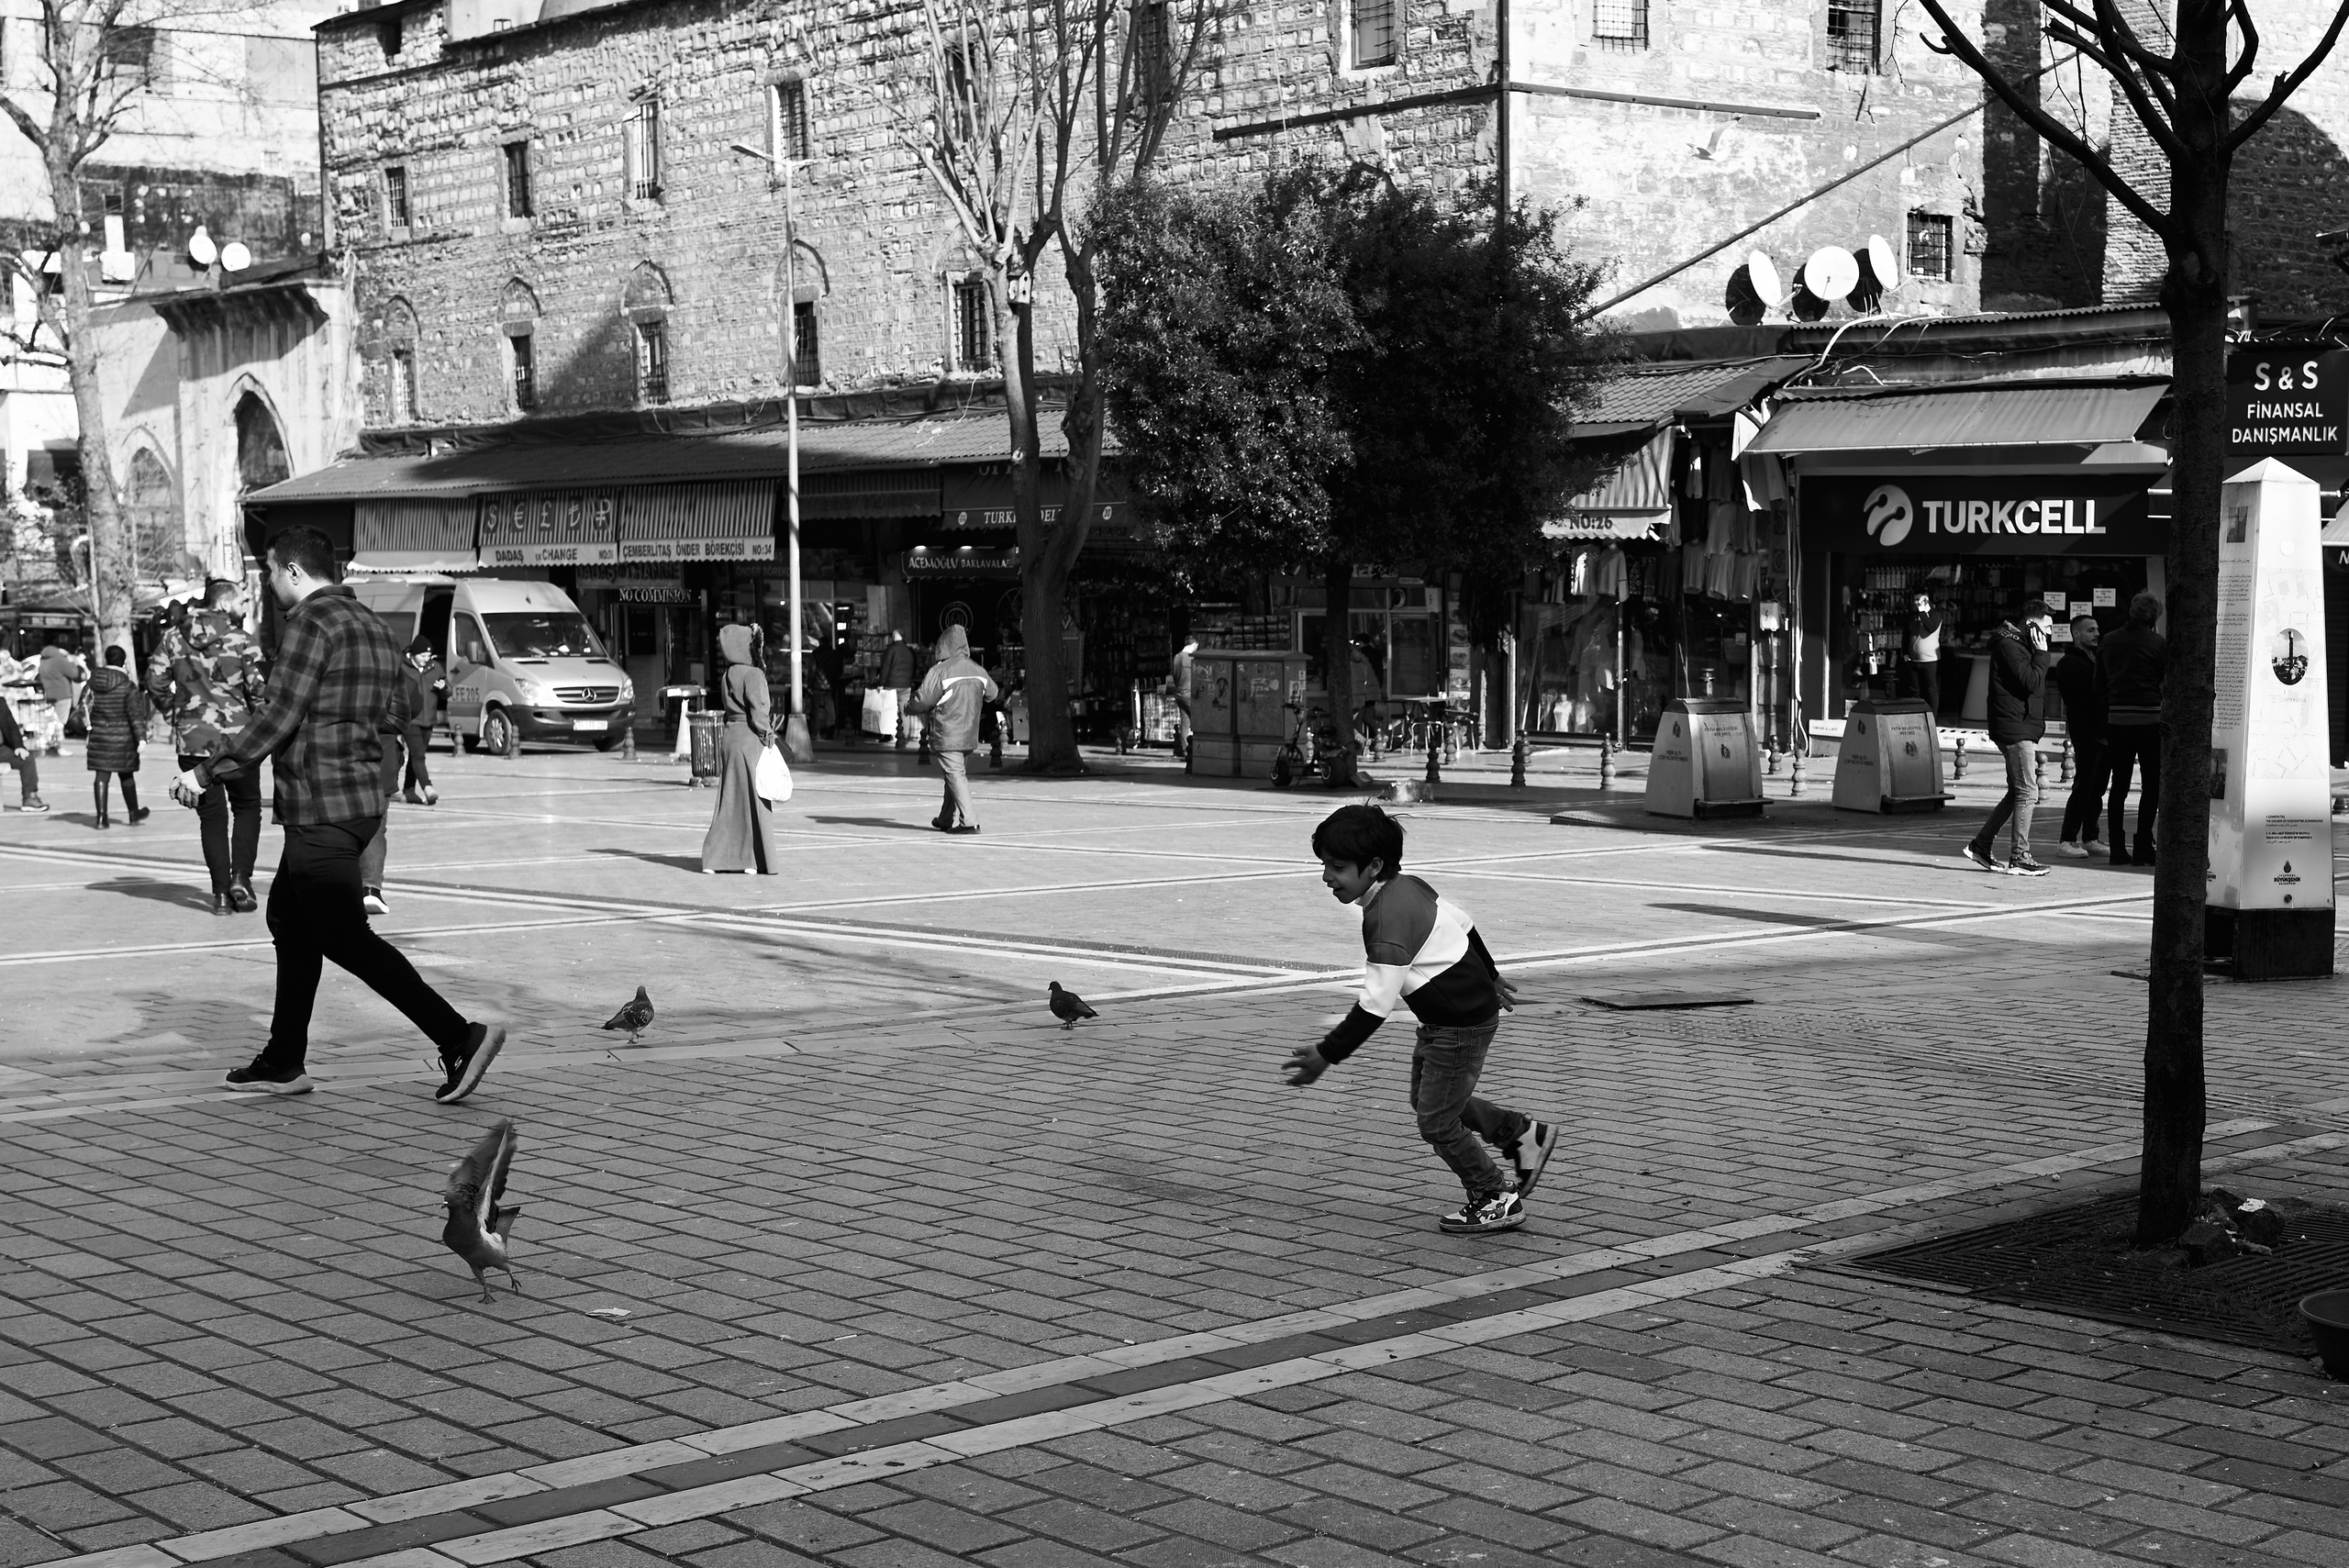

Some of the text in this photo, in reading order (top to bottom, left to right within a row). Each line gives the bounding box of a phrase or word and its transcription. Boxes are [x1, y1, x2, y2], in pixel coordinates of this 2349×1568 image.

[2254, 361, 2319, 391] S & S
[2247, 400, 2323, 419] FİNANSAL
[2232, 426, 2338, 445] DANIŞMANLIK
[984, 510, 1016, 524] TURKI
[1569, 514, 1613, 530] NO:26
[1922, 499, 2107, 534] TURKCELL
[495, 550, 524, 563] DADAŞ
[542, 548, 578, 562] CHANGE
[622, 539, 772, 559] ÇEMBERLİTAŞ ÖNDER BÖREKÇİSİ NO:34
[907, 555, 958, 570] ACEMOĞLU
[619, 588, 633, 603] NO
